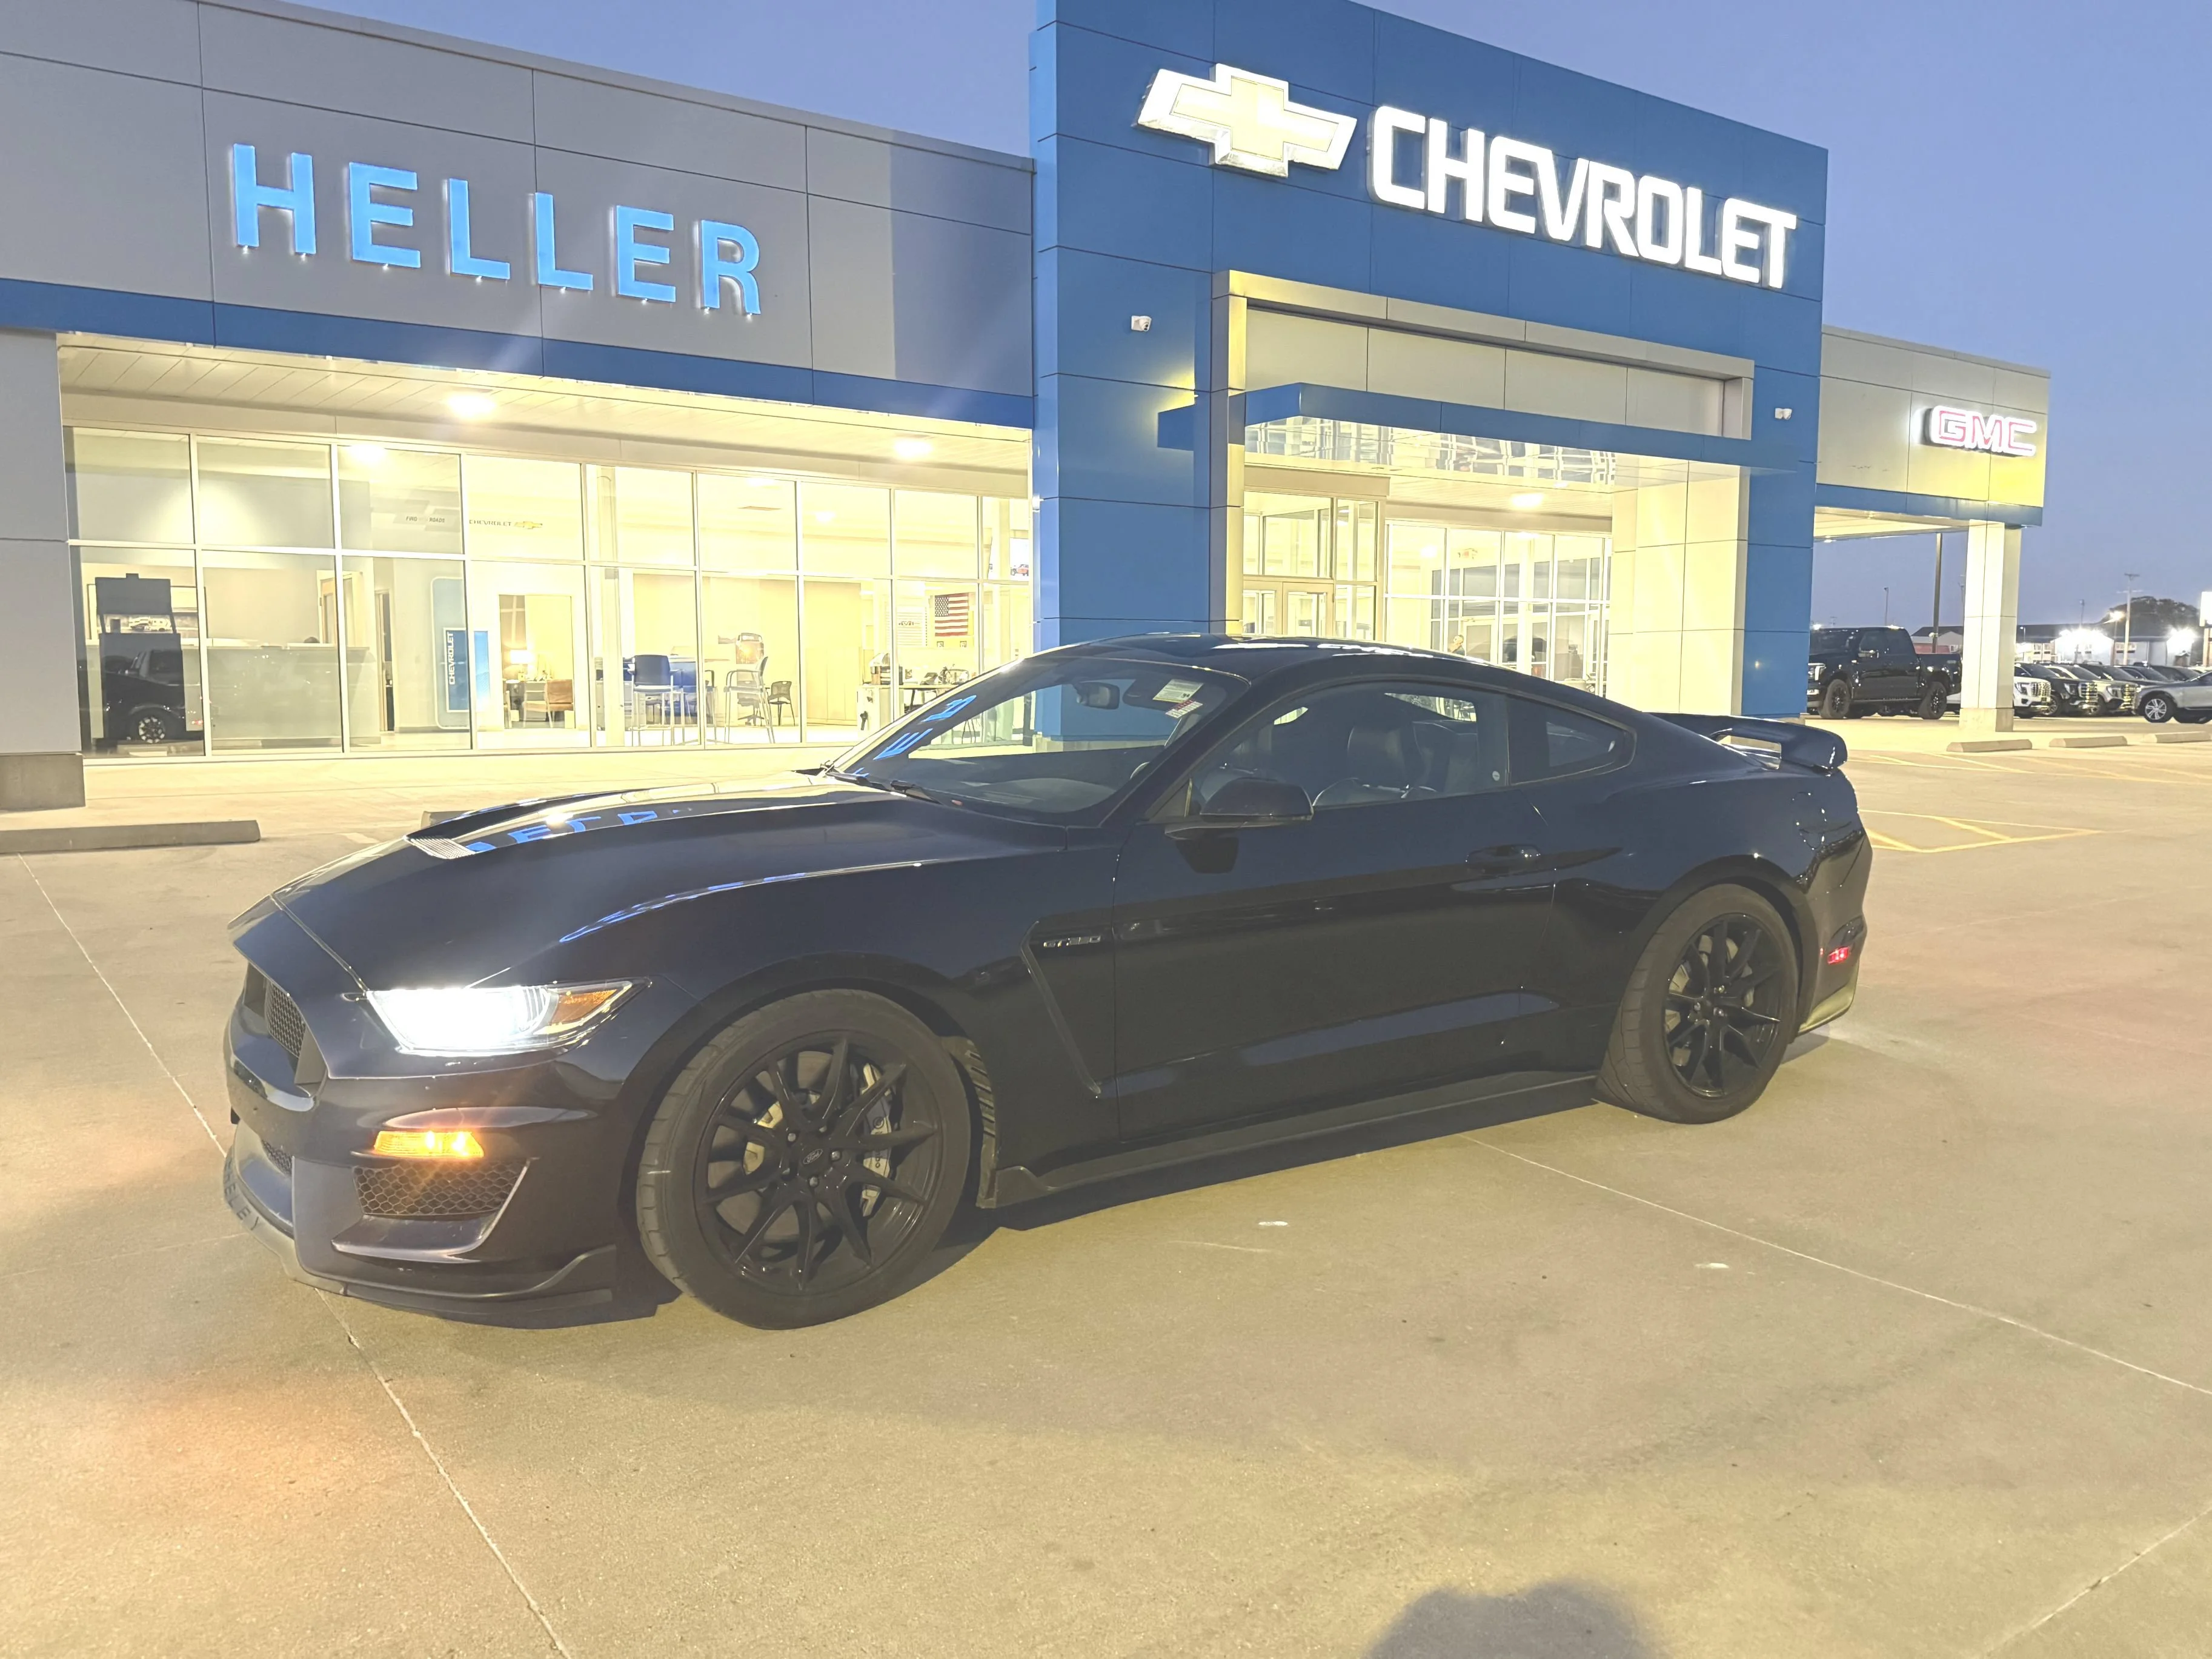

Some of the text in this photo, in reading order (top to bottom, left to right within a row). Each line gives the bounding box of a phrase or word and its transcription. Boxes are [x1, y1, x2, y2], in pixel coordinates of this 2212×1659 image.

[231, 142, 762, 314] HELLER
[1368, 105, 1797, 289] CHEVROLET
[1931, 406, 2036, 456] GMC
[447, 631, 456, 685] CHEVROLET
